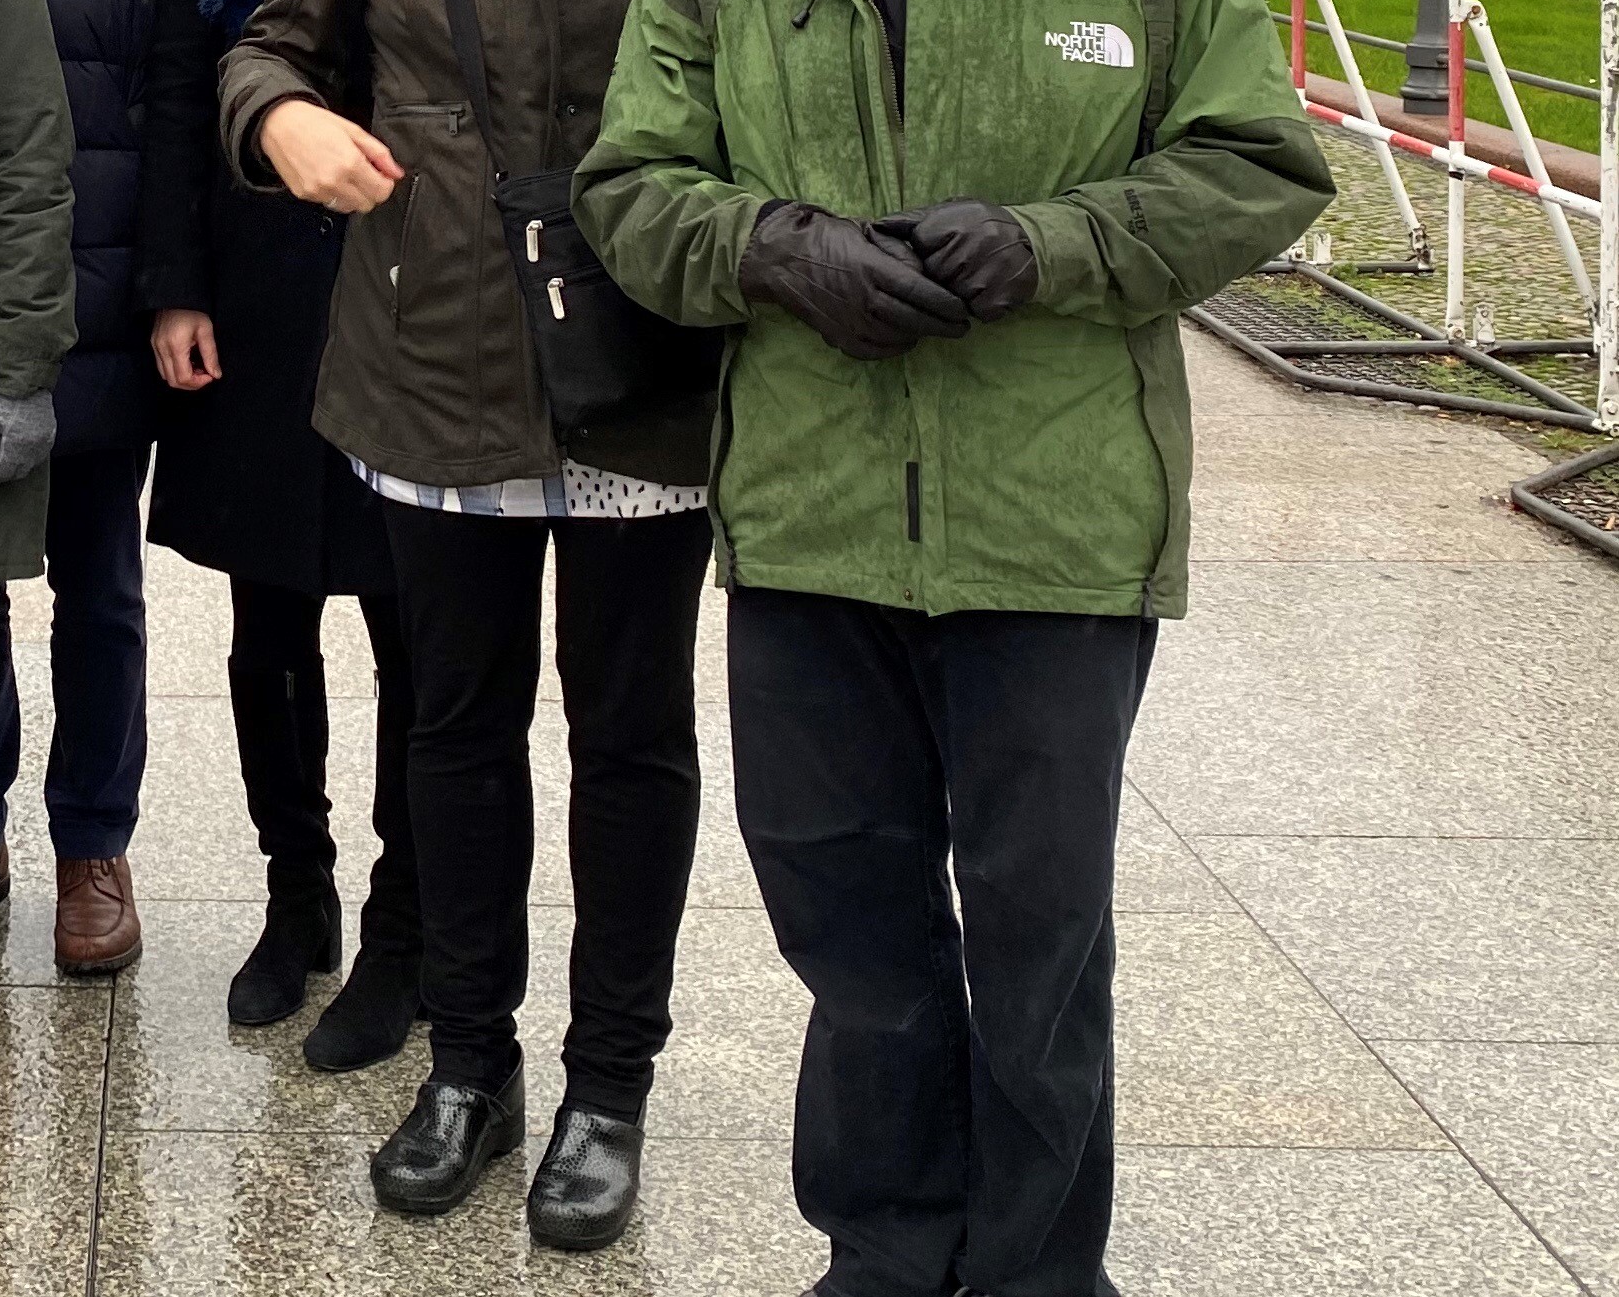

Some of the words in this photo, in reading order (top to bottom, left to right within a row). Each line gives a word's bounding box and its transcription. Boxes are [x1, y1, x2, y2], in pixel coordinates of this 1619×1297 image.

[1069, 21, 1105, 37] THE
[1045, 31, 1104, 51] NORTH
[1062, 47, 1105, 64] FACE
